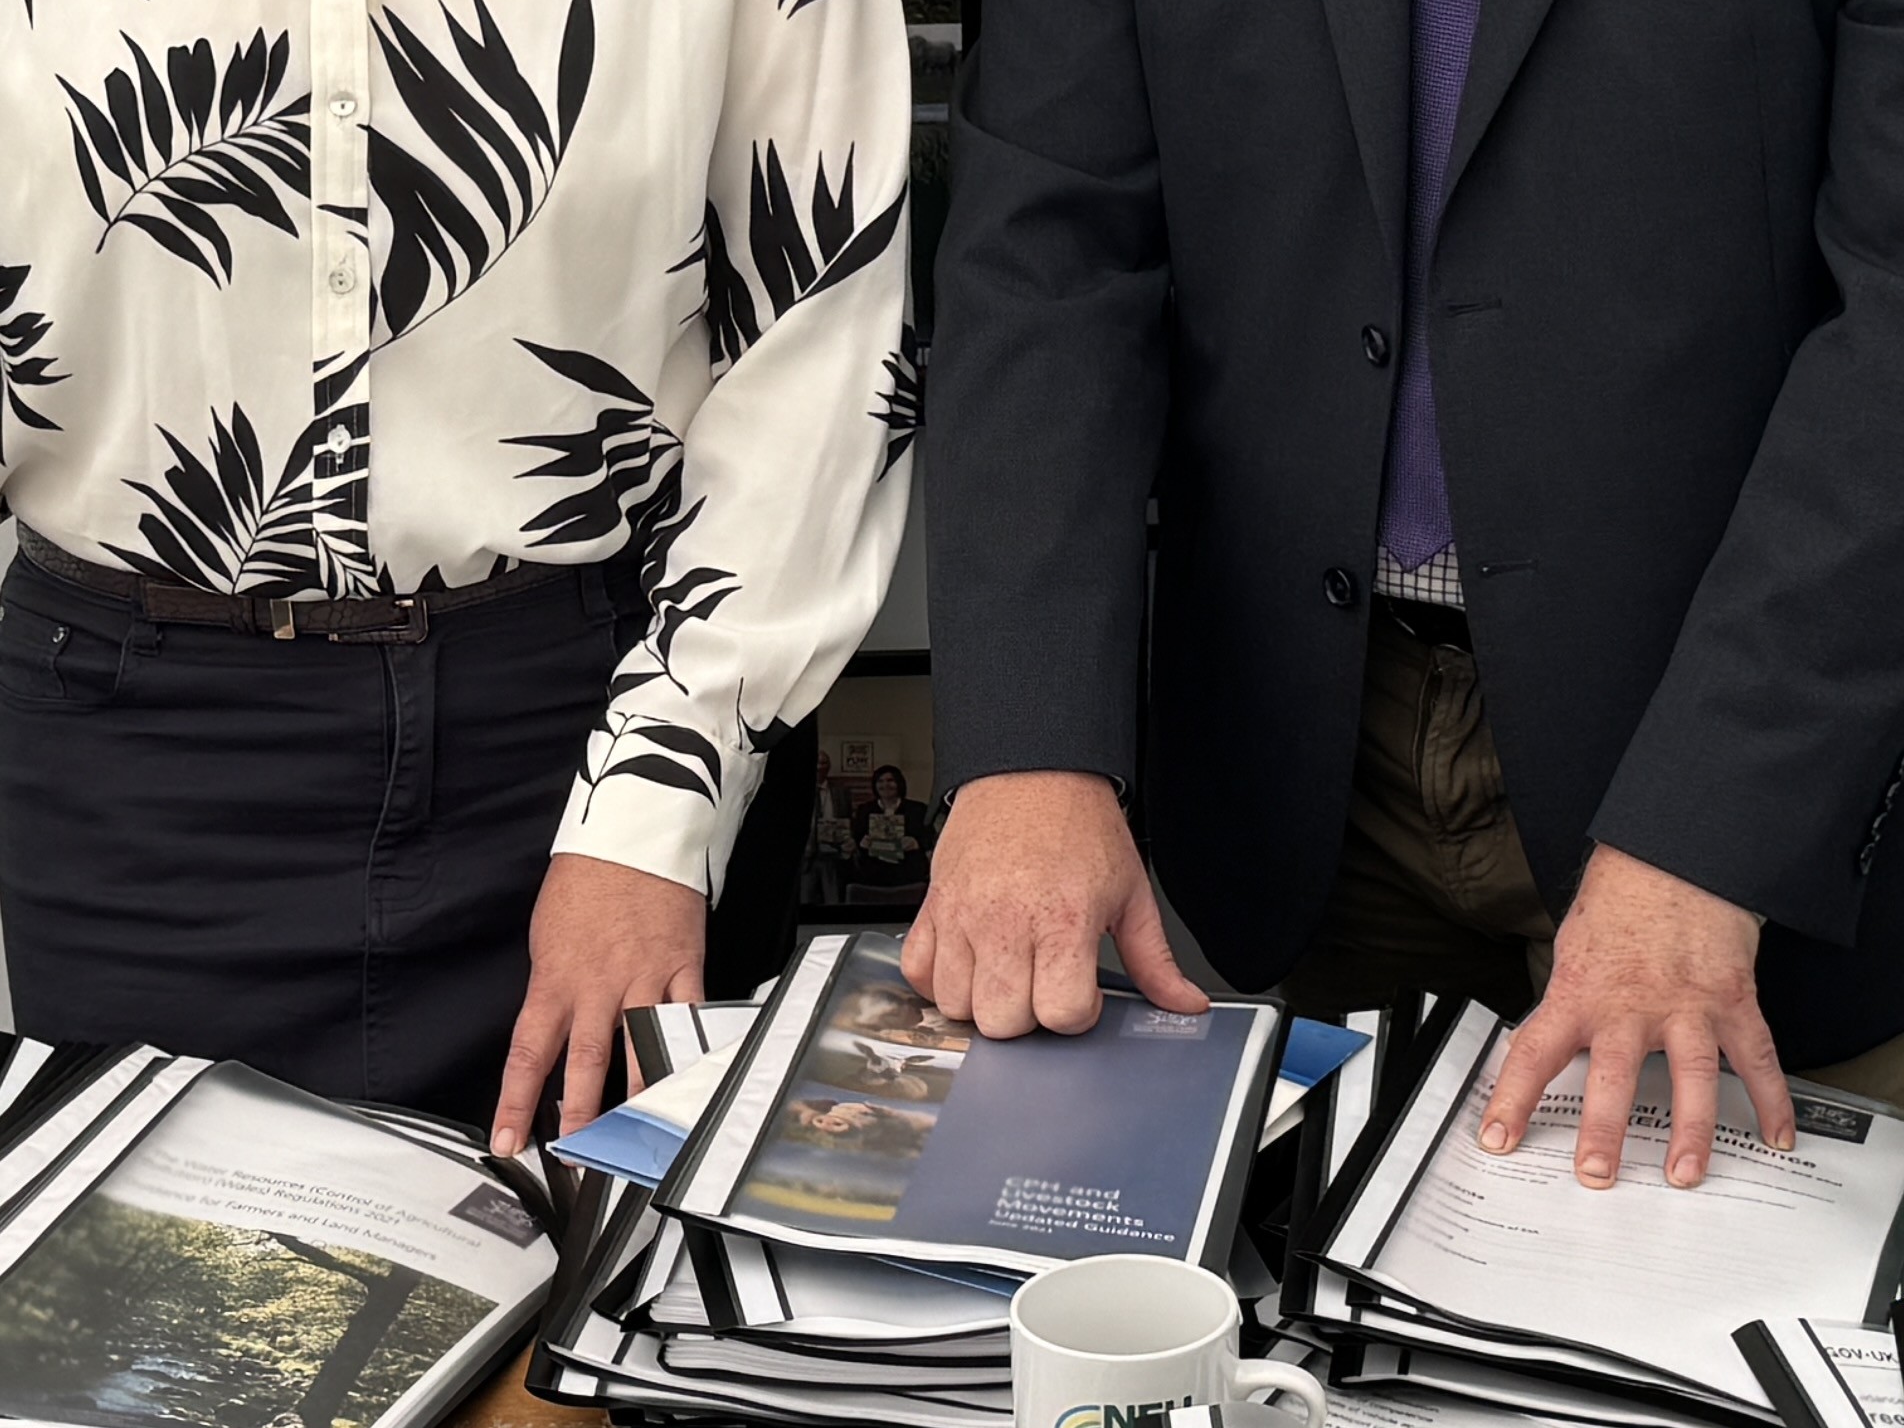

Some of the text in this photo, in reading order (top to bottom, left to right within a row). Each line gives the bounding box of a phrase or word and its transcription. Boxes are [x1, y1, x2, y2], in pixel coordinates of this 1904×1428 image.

[232, 1170, 305, 1190] Resources
[1006, 1177, 1120, 1200] CPH and
[274, 1187, 359, 1214] Regulations
[997, 1198, 1143, 1227] Movements
[1001, 1187, 1119, 1212] Livestock
[225, 1200, 436, 1261] Farmers and Land Managers
[995, 1209, 1175, 1242] Updated Guidance
